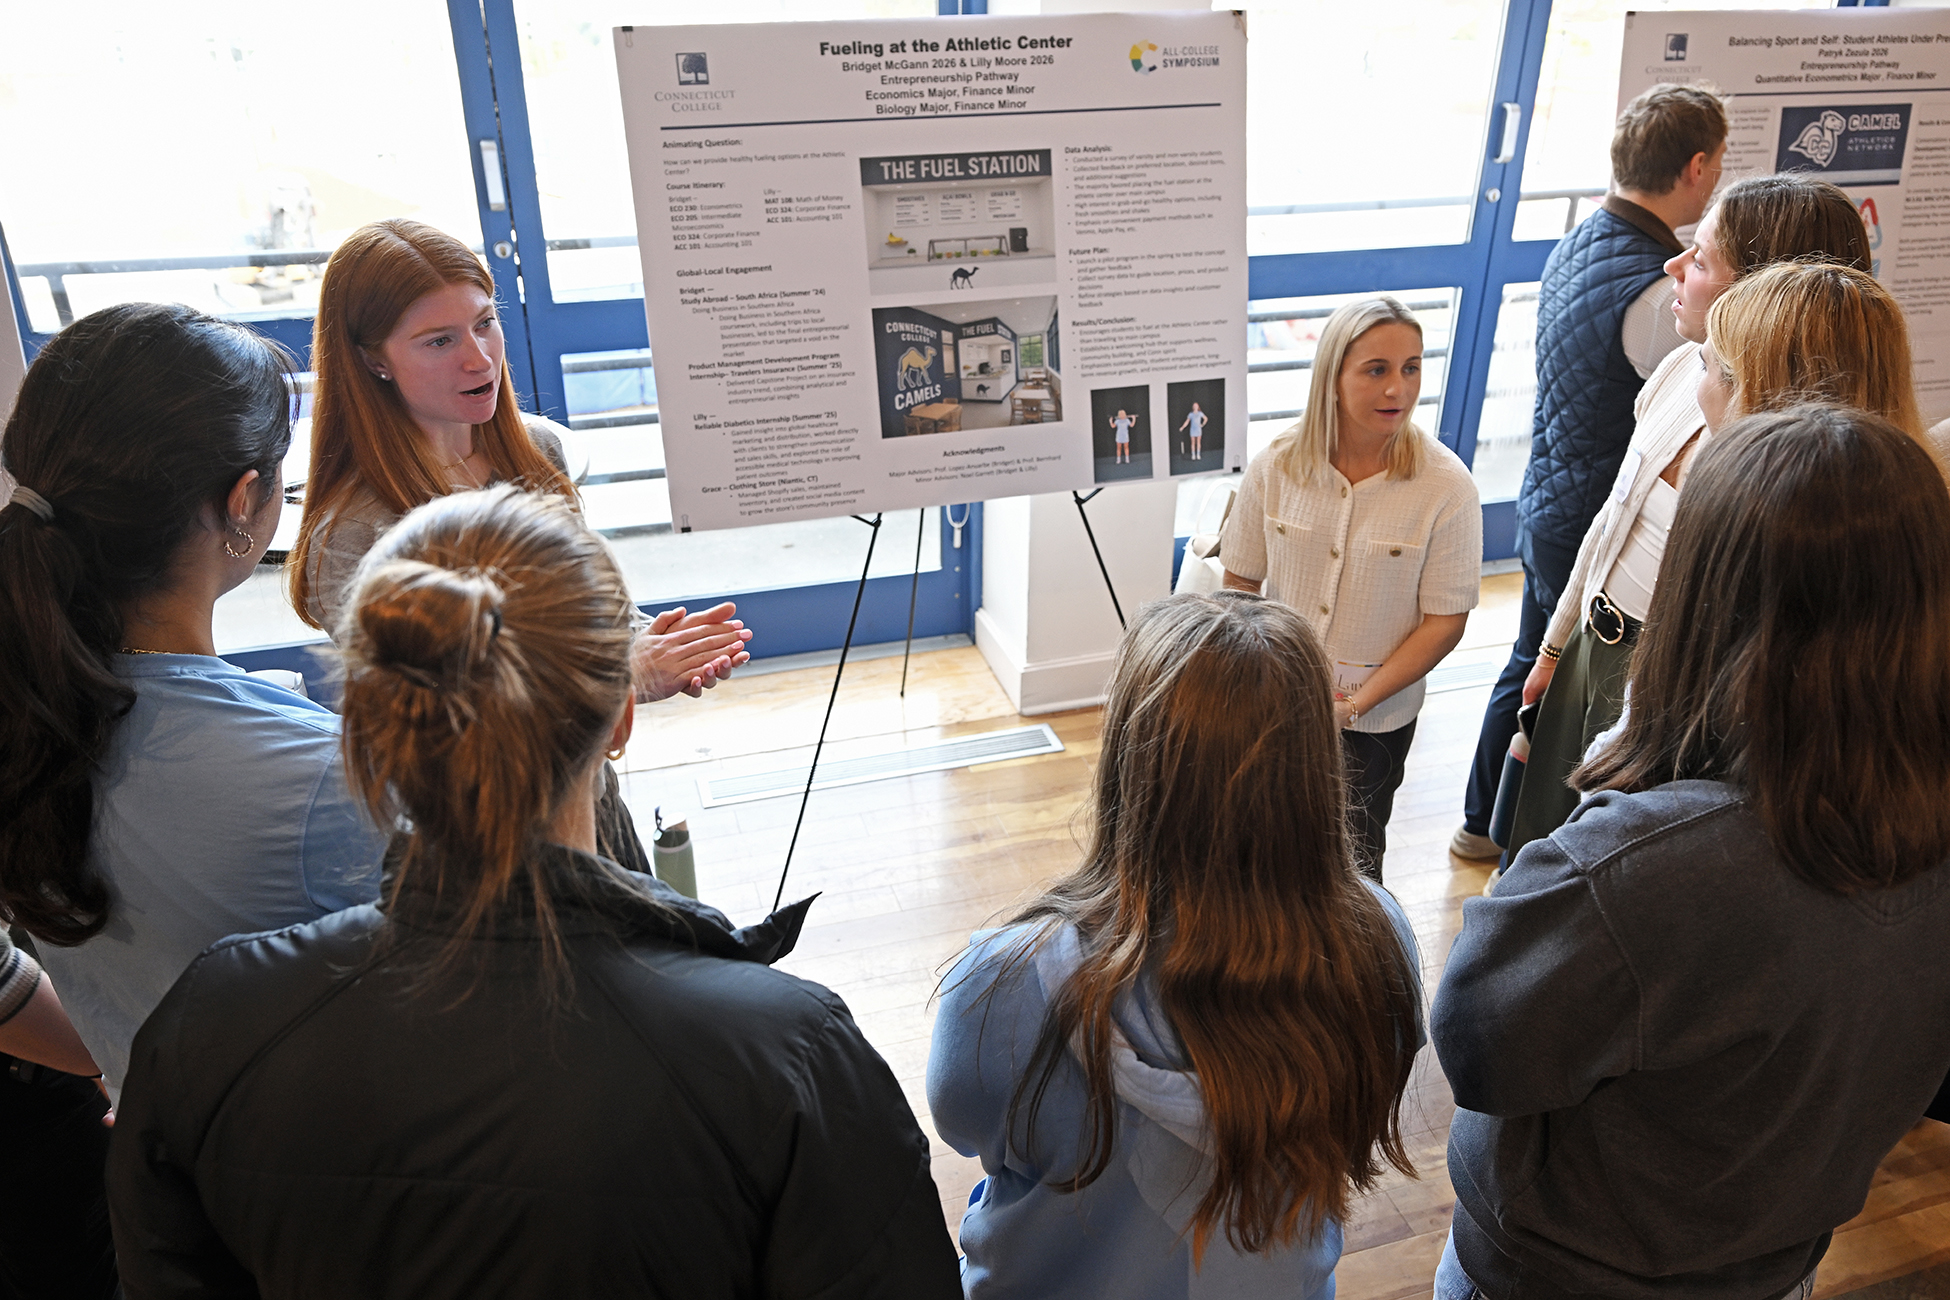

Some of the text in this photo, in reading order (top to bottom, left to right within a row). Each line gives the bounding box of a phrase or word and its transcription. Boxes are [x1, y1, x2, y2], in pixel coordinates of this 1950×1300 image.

[820, 36, 1072, 57] Fueling at the Athletic Center
[1729, 37, 1773, 48] Balancing
[1775, 36, 1799, 47] Sport
[1801, 36, 1818, 45] and
[1820, 35, 1841, 45] Self:
[1843, 35, 1875, 44] Student
[1876, 35, 1909, 44] Athletes
[1910, 34, 1934, 44] Under
[1162, 46, 1219, 56] ALL-COLLEGE
[1818, 49, 1843, 58] Patryk
[1871, 48, 1889, 56] 2026
[842, 55, 1054, 73] Bridget McGann 2026 & Lilly Moore 2026
[1163, 57, 1219, 68] SYMPOSIUM
[1800, 60, 1900, 70] Entrepreneurship Pathway
[880, 72, 1019, 85] Entrepreneurship Pathway
[1755, 75, 1803, 83] Quantitative
[1805, 74, 1858, 82] Econometrics
[1886, 72, 1915, 80] Finance
[1916, 71, 1937, 80] Minor
[866, 89, 924, 100] Economics
[962, 86, 1003, 96] Finance
[1006, 85, 1035, 94] Minor
[671, 102, 722, 112] COLLEGE
[876, 104, 916, 115] Biology
[954, 101, 995, 110] Finance
[998, 100, 1027, 108] Minor
[1848, 114, 1901, 131] CAMEL
[1848, 136, 1896, 144] ATHLETICS
[880, 154, 1040, 180] THE FUEL STATION
[676, 265, 772, 277] Global-Local Engagement
[1072, 317, 1137, 326] Results/Conclusion:
[886, 322, 937, 339] CONNECTICUT
[962, 326, 975, 336] THE
[976, 323, 995, 334] FUEL
[901, 332, 930, 344] COLLEGE
[717, 359, 763, 368] Management
[764, 355, 810, 364] Development
[894, 384, 942, 410] CAMELS
[943, 446, 1005, 457] Acknowledgments
